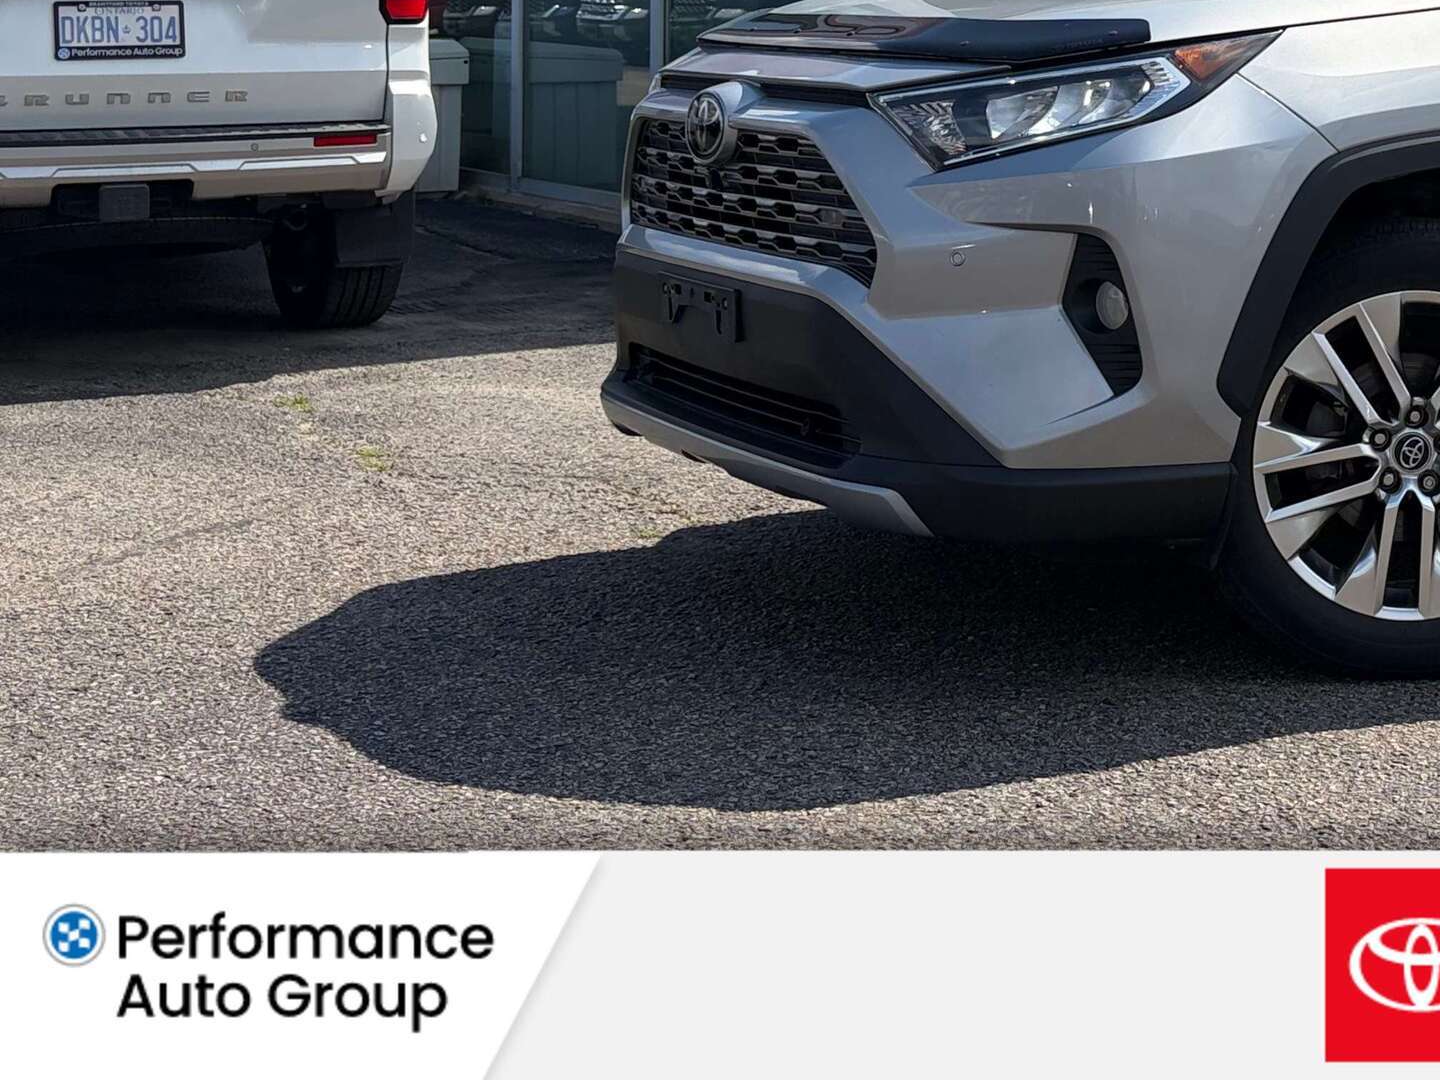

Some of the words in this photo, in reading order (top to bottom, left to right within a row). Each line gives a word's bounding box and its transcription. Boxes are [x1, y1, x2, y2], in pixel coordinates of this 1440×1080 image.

[60, 15, 120, 44] DKBN
[135, 15, 178, 43] 304
[71, 48, 132, 57] Performance
[133, 47, 154, 56] Auto
[155, 46, 183, 57] Group
